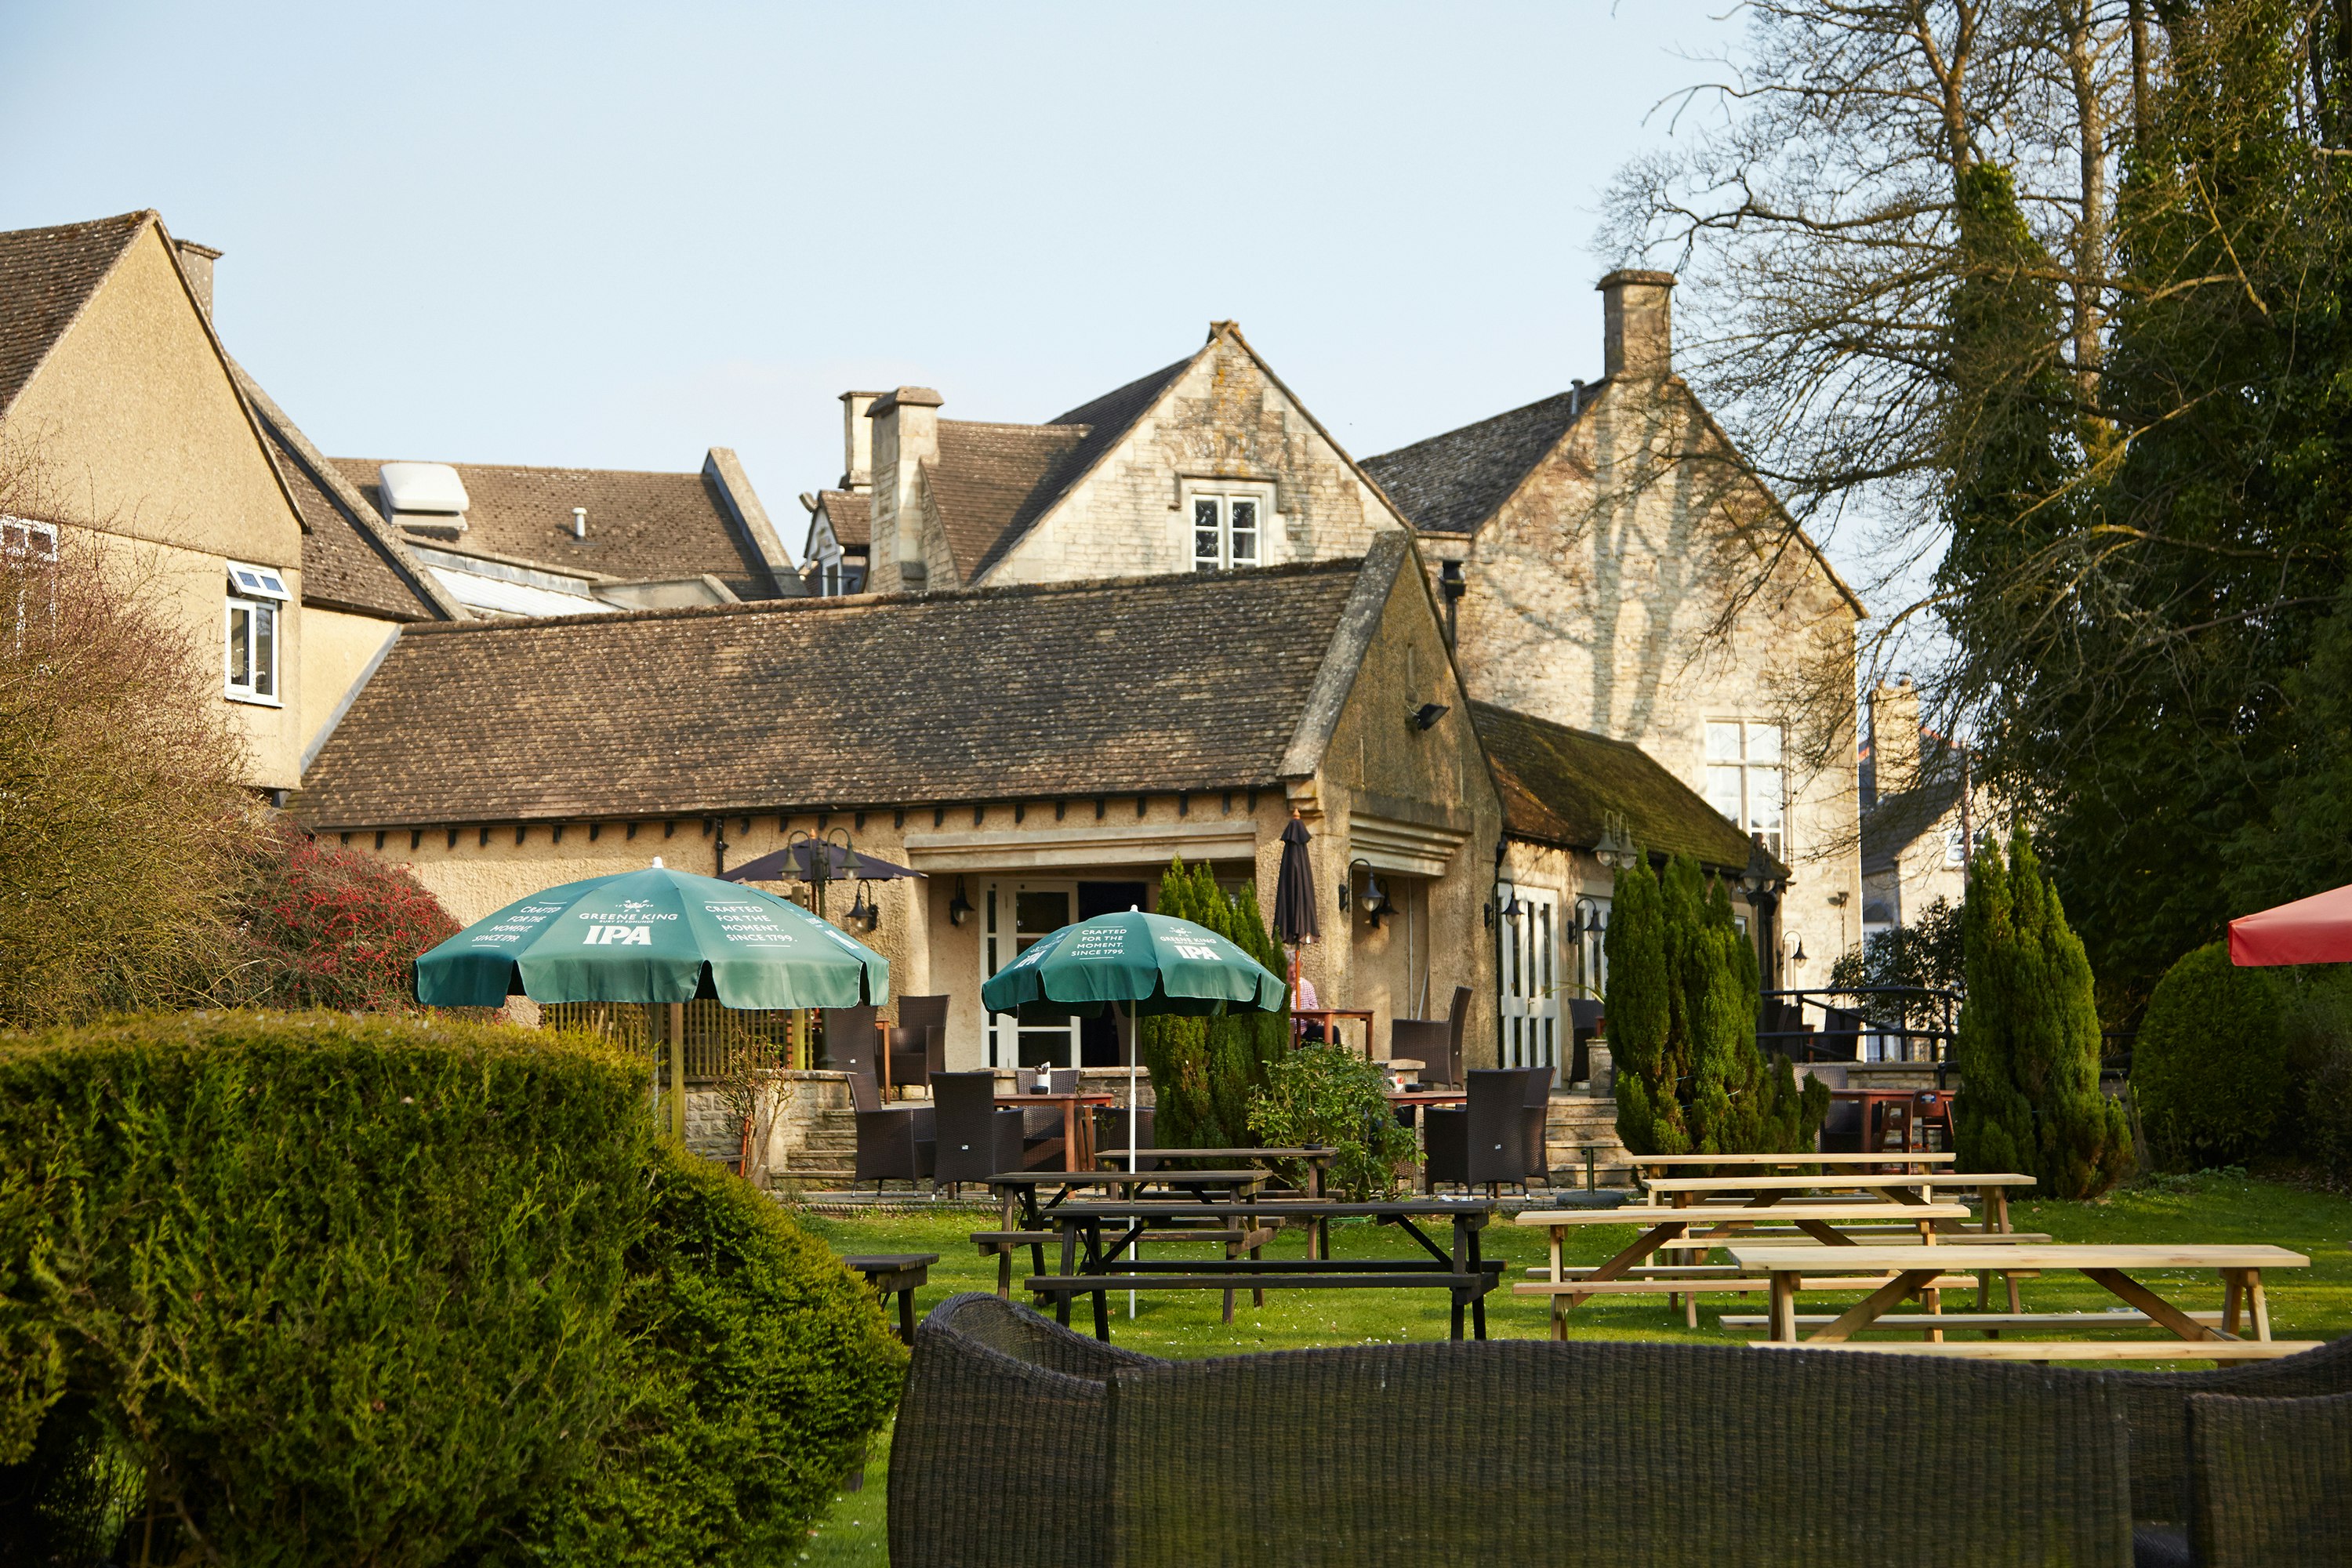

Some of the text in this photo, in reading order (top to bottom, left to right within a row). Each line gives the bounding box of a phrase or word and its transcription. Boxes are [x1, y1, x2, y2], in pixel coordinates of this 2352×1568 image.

[583, 925, 652, 946] IPA
[765, 934, 797, 942] 1799.
[1174, 946, 1222, 960] IPA
